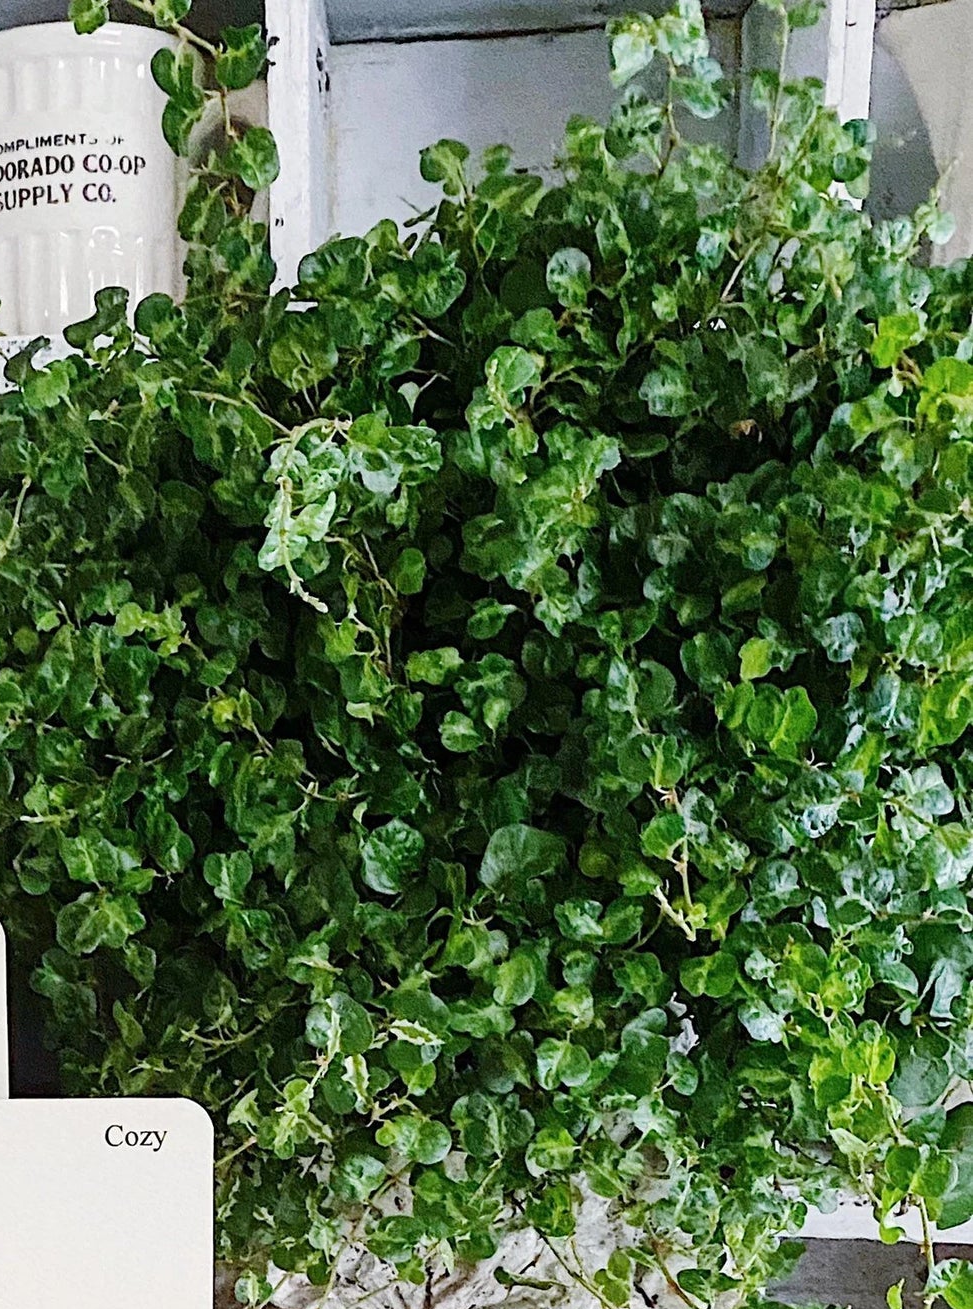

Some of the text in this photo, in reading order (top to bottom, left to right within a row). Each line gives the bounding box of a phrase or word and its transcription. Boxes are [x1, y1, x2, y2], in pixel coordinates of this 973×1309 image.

[82, 154, 146, 175] CO-OP
[82, 183, 117, 203] CO.
[104, 1124, 167, 1152] Cozy
